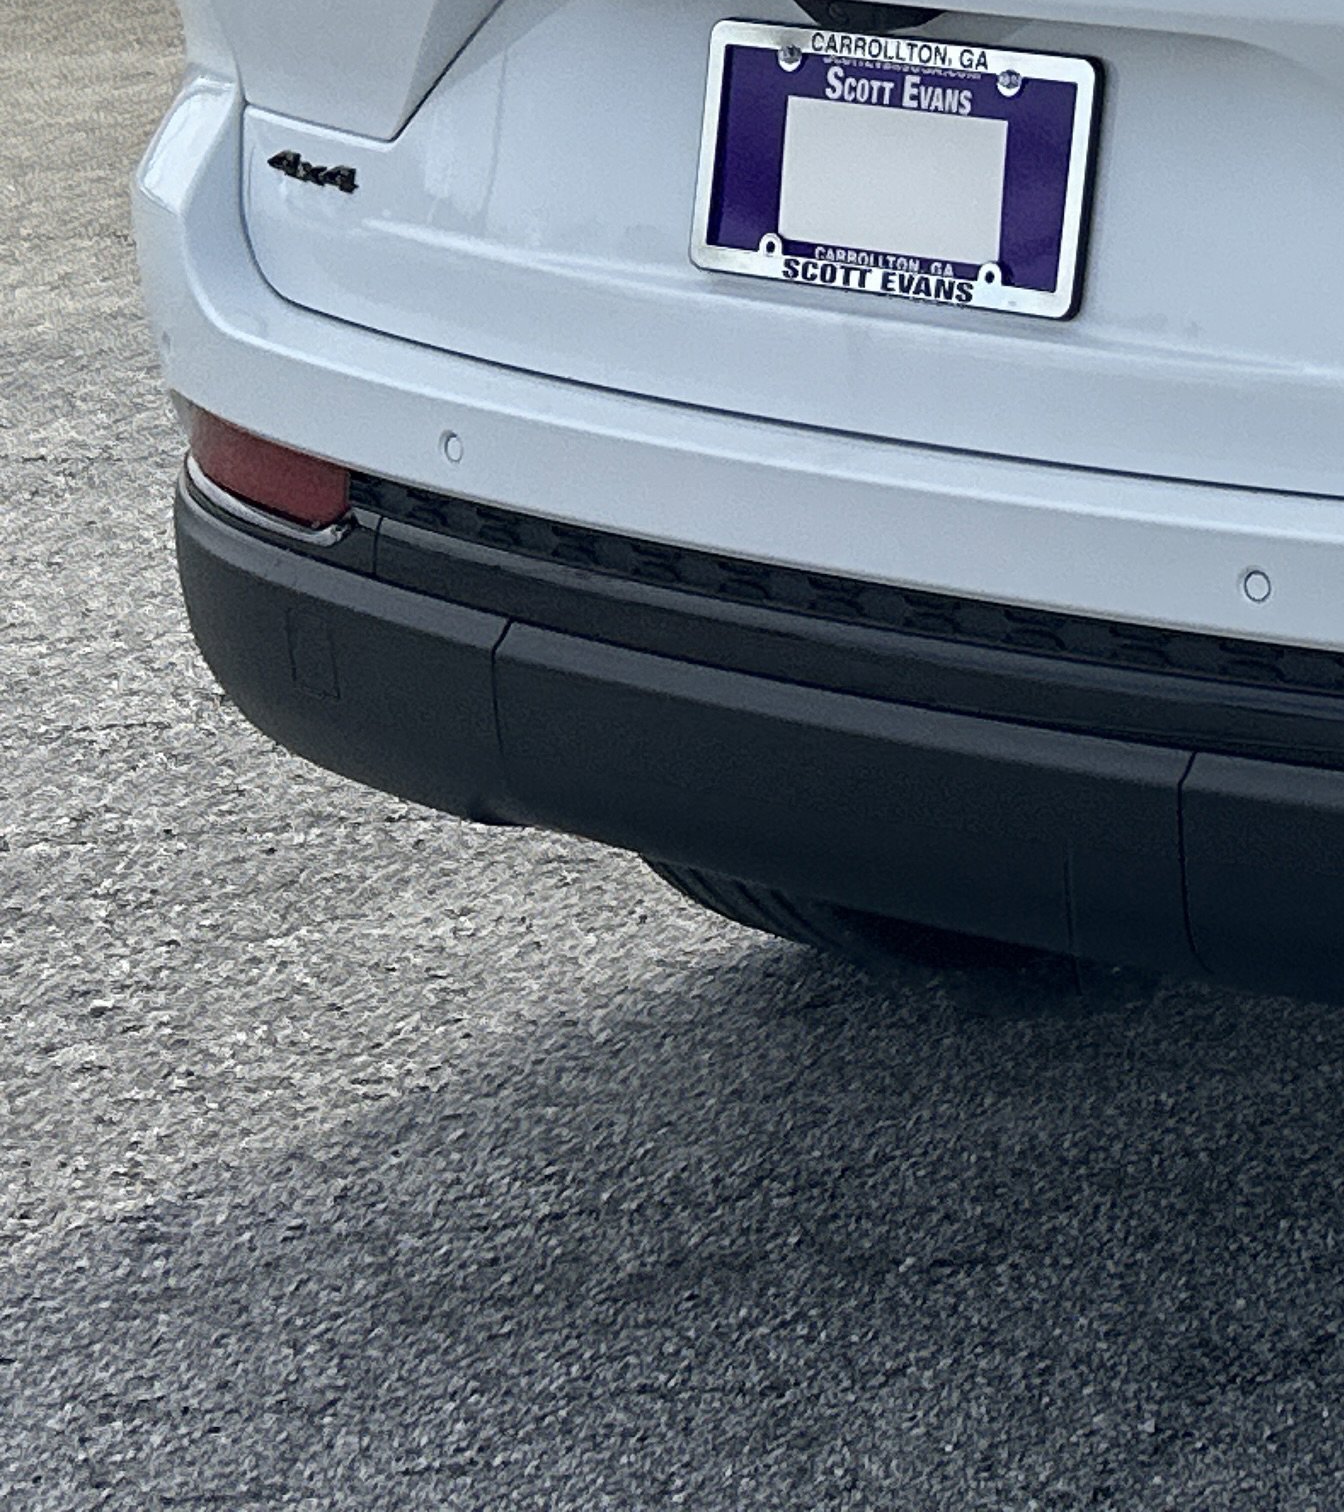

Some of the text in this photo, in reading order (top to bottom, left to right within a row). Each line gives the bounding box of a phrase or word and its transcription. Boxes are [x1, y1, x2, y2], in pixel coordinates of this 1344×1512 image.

[959, 48, 989, 71] GA
[930, 261, 955, 277] GA
[782, 258, 975, 304] SCOTT EVANS
